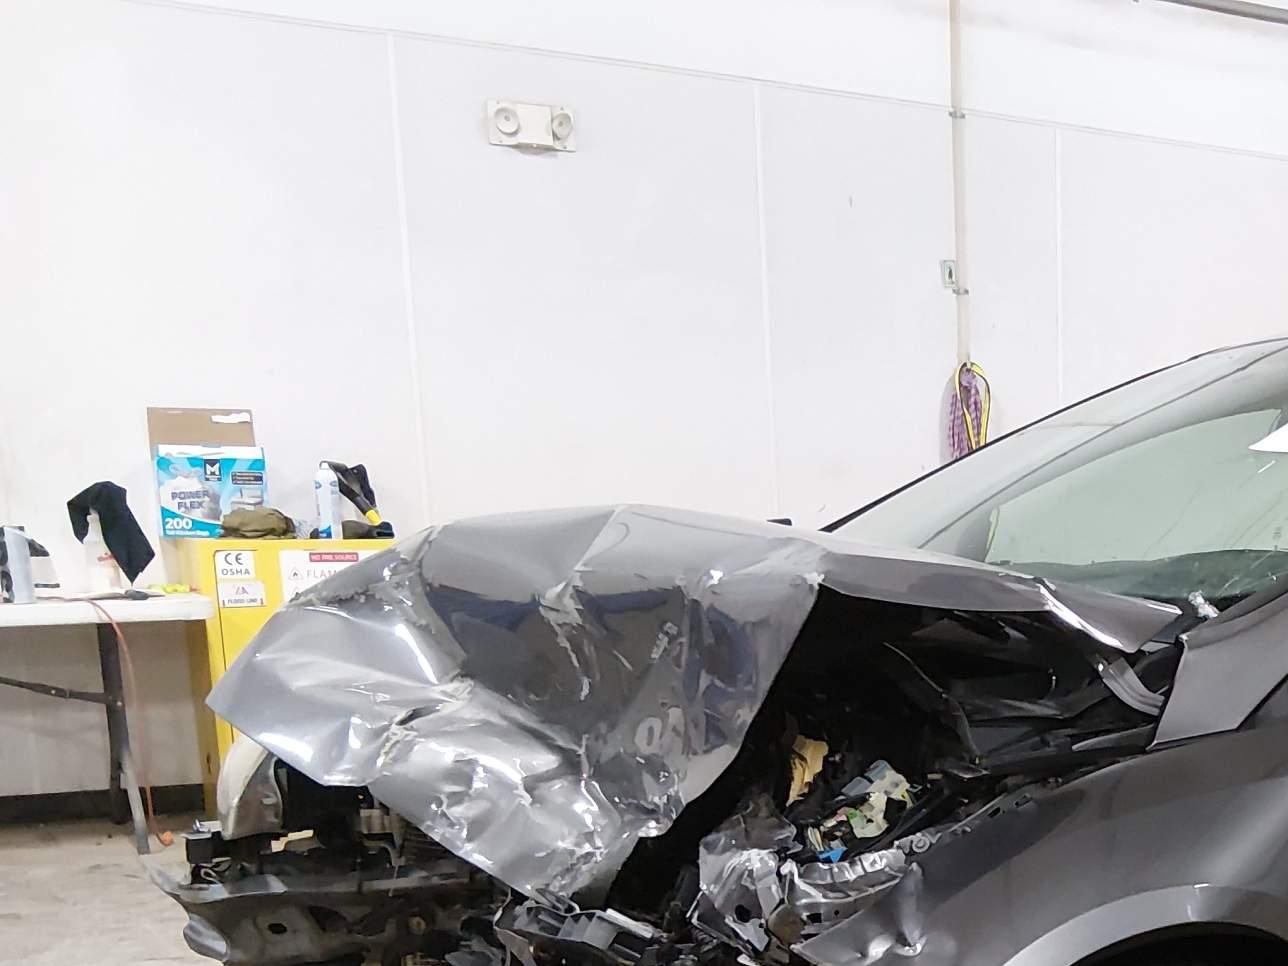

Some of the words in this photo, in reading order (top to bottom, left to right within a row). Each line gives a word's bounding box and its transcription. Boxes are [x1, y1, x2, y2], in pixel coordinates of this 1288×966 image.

[170, 489, 210, 501] POWER
[177, 499, 206, 512] FLEX
[164, 518, 193, 530] 200
[224, 552, 244, 566] CE
[221, 568, 251, 576] OSHA
